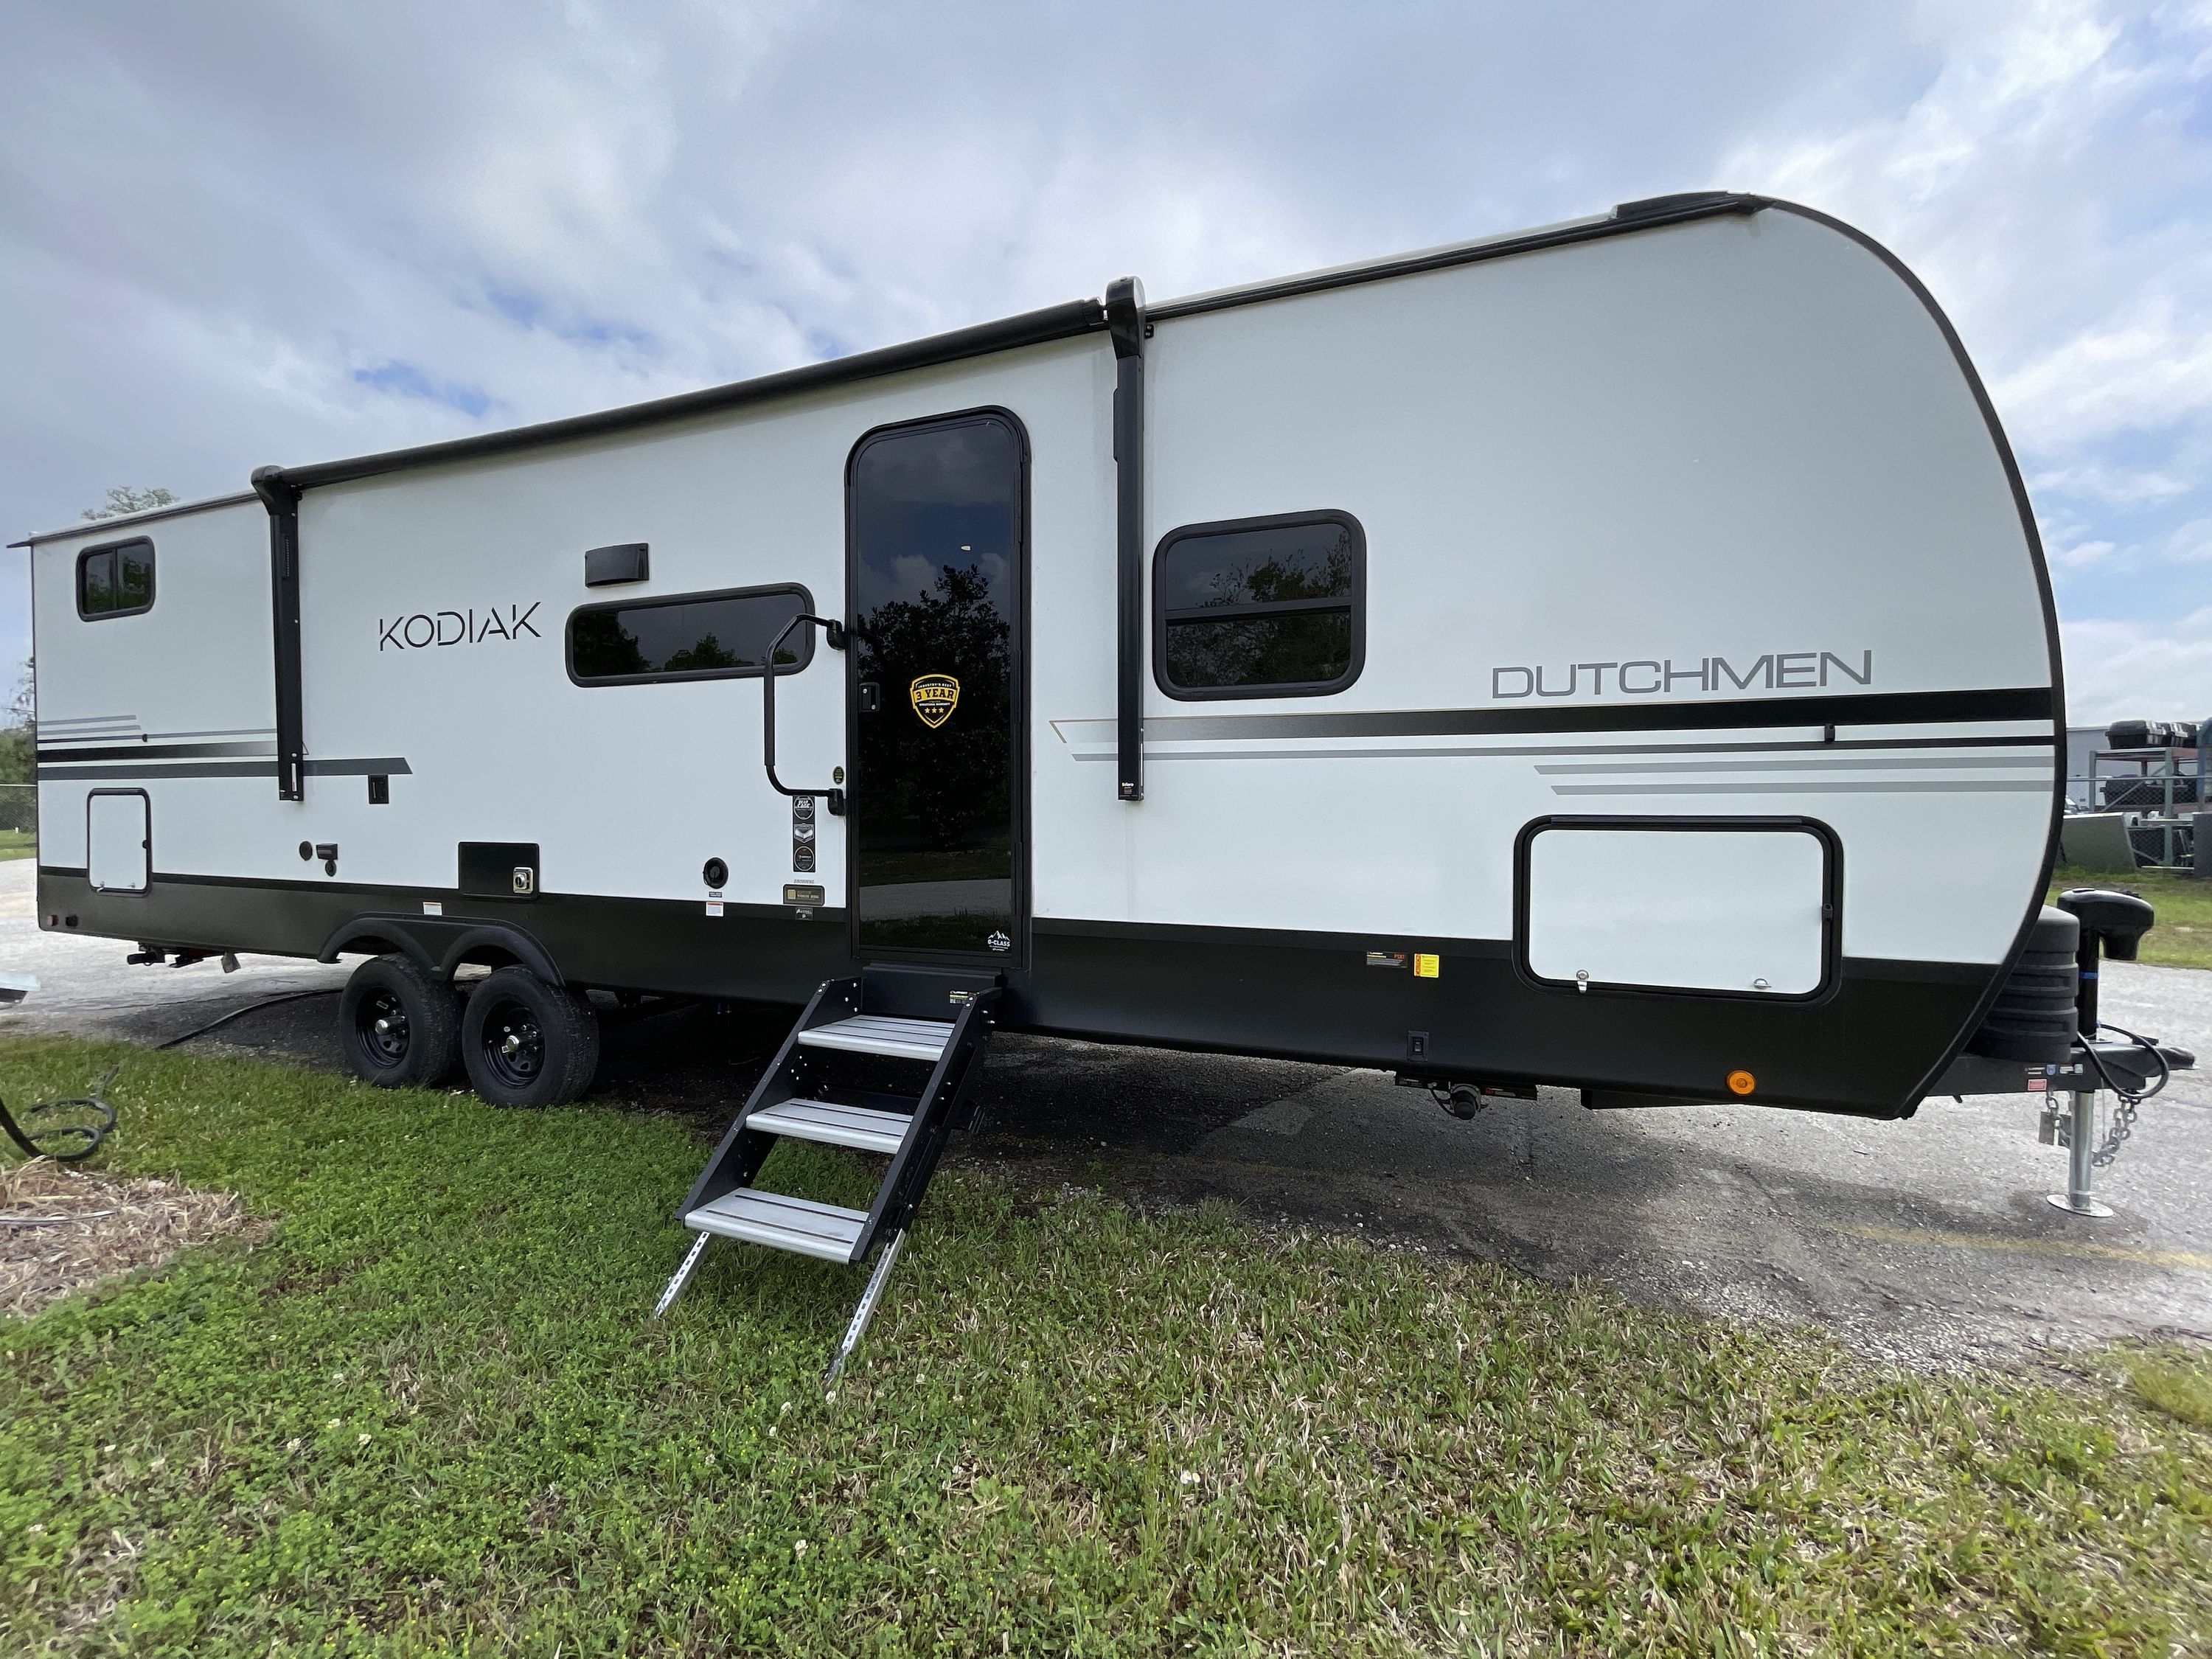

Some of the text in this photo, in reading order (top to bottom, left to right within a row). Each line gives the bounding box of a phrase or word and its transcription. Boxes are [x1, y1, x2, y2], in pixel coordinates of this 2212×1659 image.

[380, 602, 541, 651] KODIAK
[916, 688, 954, 700] 3 YEAR
[1492, 650, 1871, 698] DUTCHMEN
